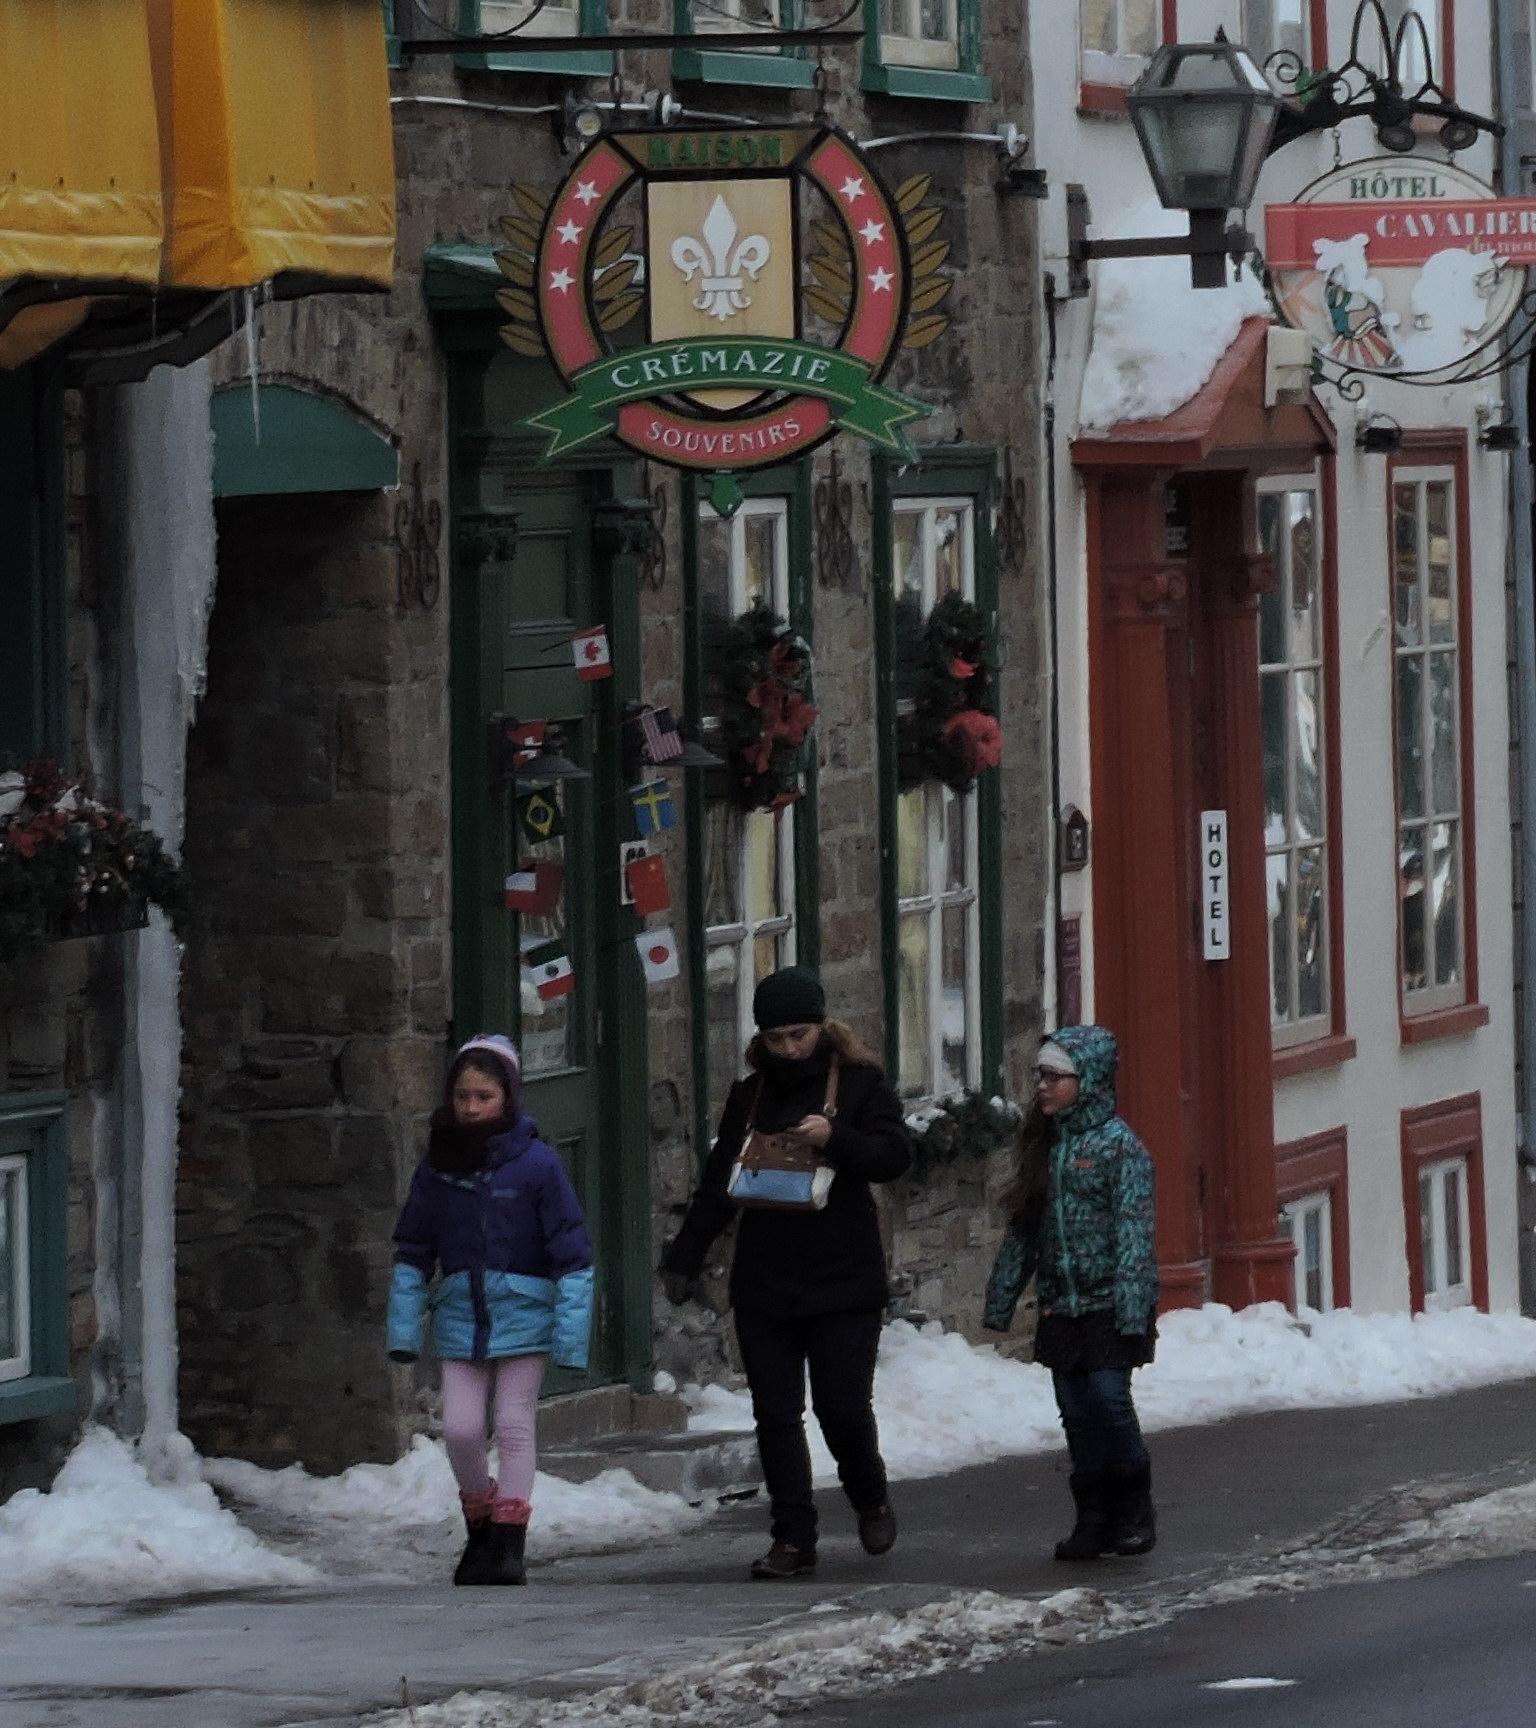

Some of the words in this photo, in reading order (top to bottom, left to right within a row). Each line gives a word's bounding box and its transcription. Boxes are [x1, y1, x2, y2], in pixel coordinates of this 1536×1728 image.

[650, 136, 782, 167] MAISON
[1350, 173, 1446, 199] HÔTEL
[611, 345, 831, 388] CRÉMAZIE
[647, 419, 801, 454] SOUVENIRS
[1208, 825, 1222, 946] HOTEL
